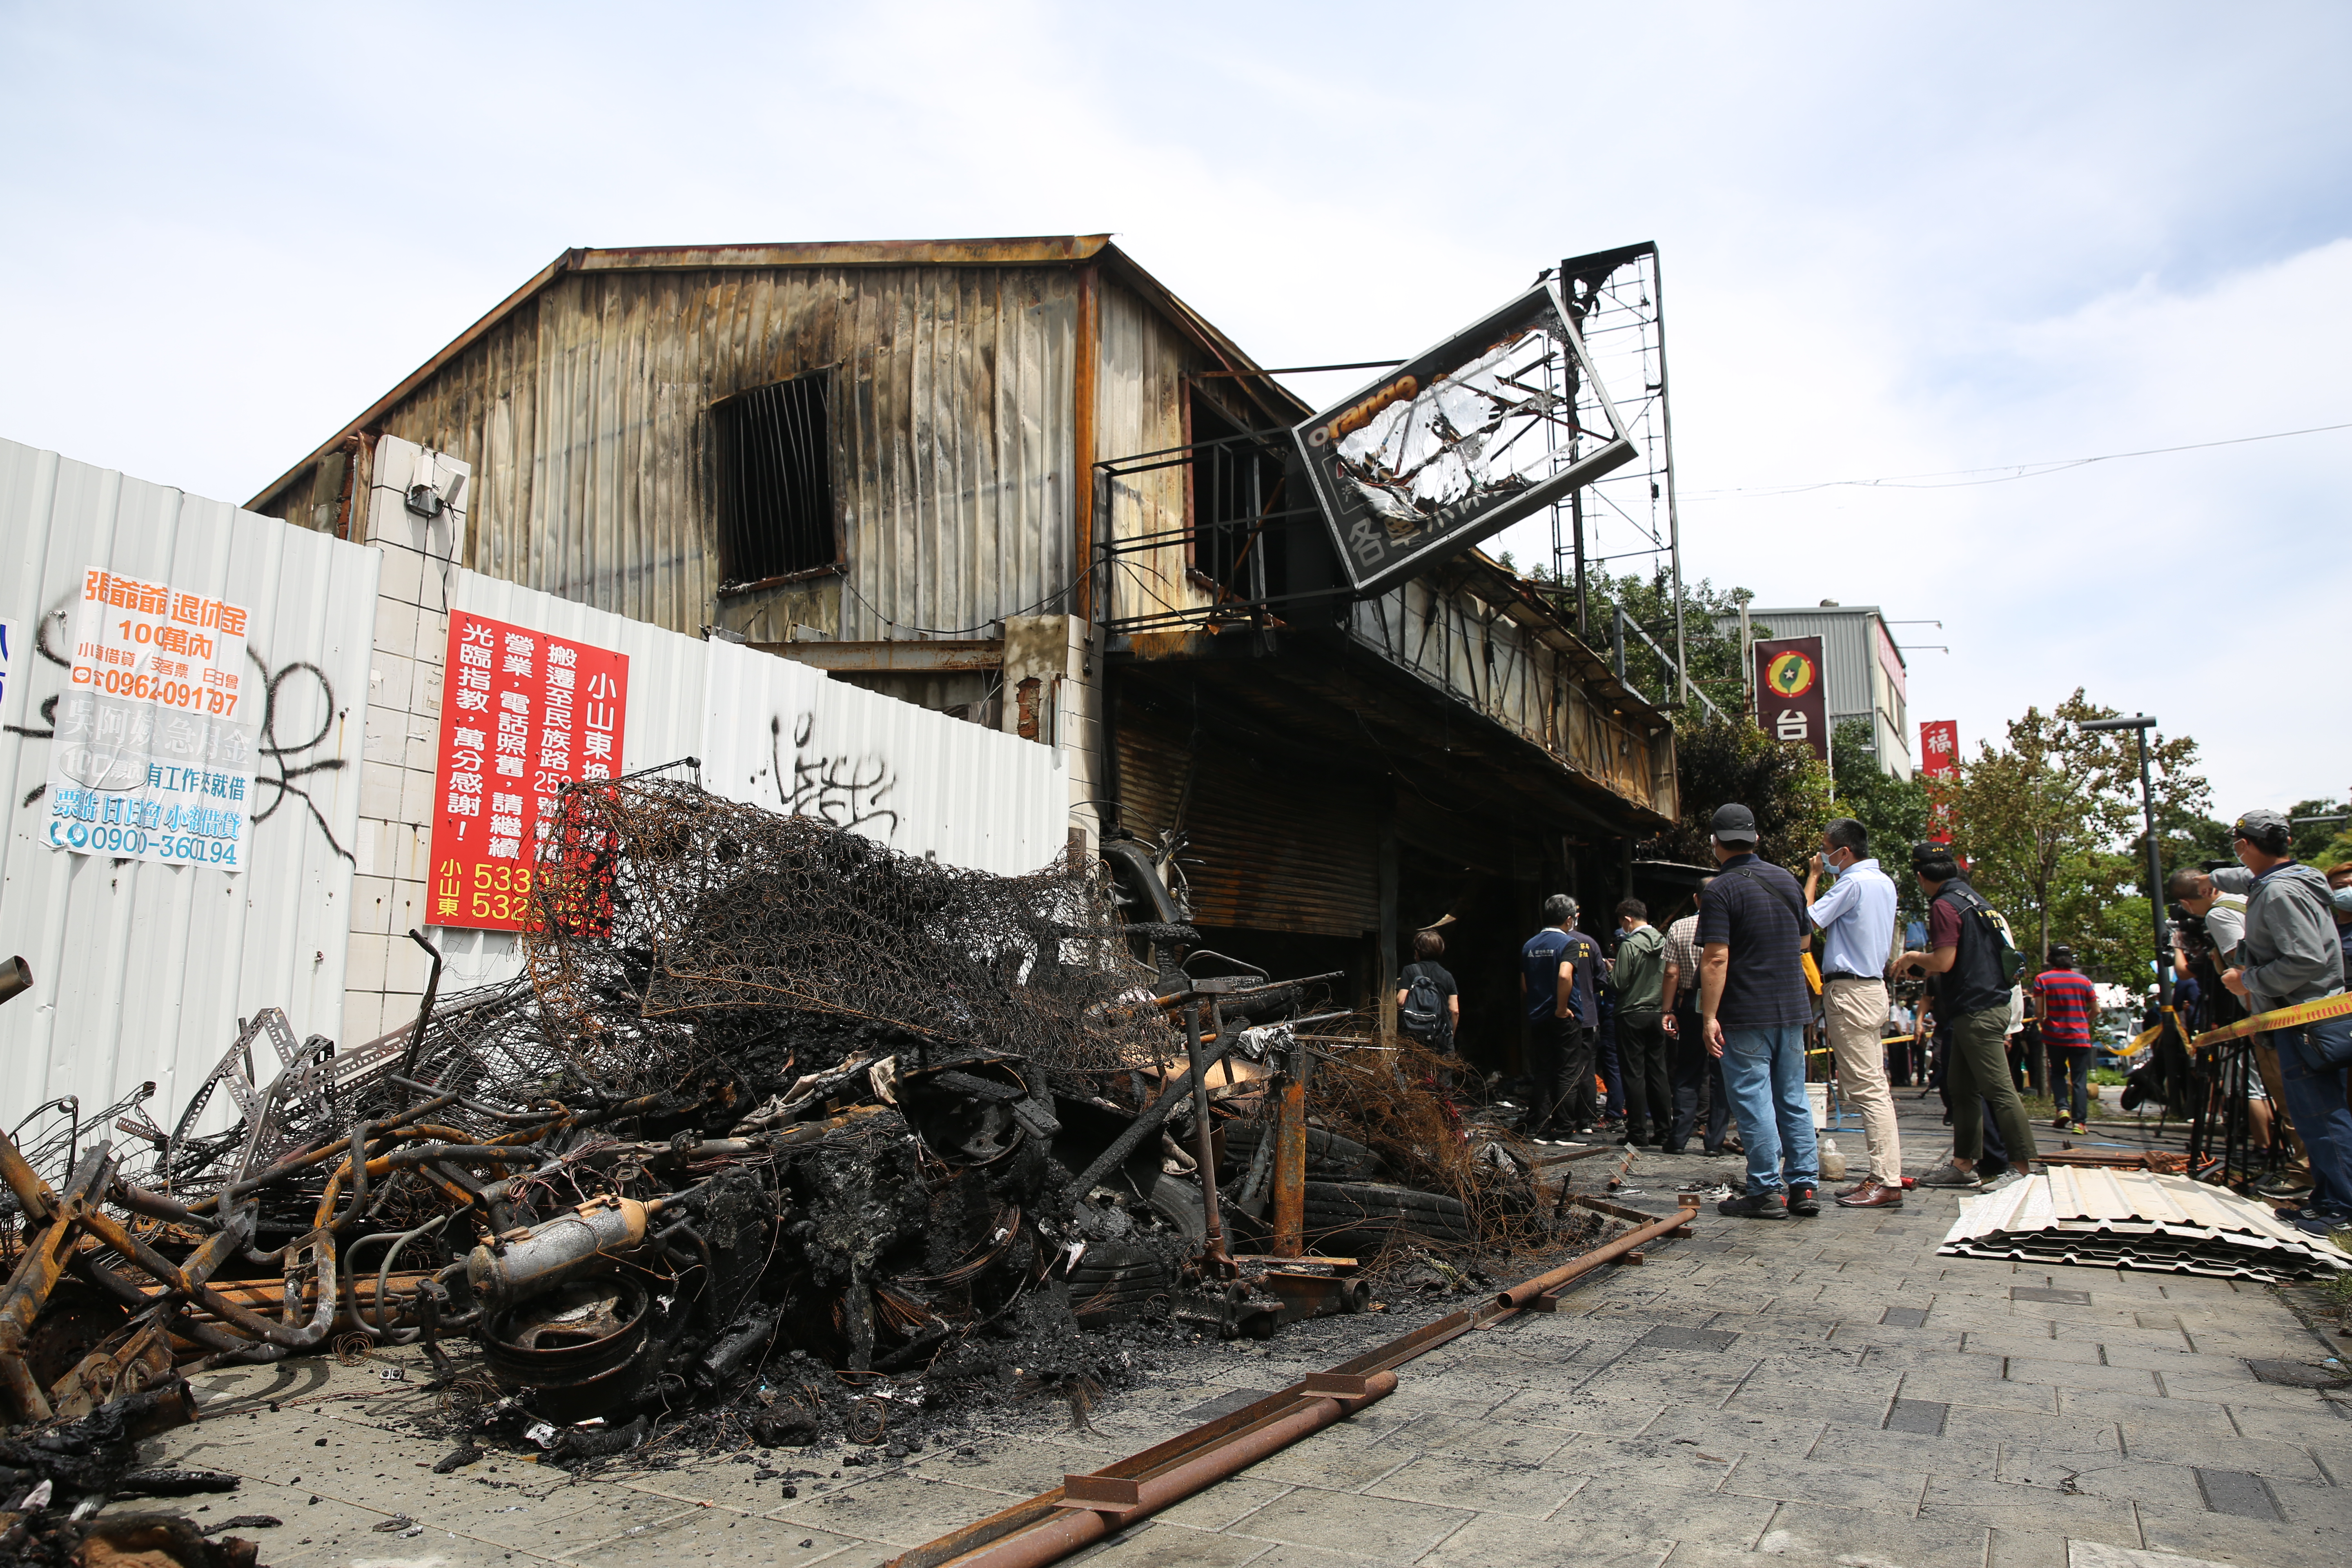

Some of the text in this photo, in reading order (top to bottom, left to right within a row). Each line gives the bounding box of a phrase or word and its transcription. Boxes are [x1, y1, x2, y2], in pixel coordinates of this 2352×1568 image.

[85, 570, 247, 637] 張爺爺 退休金
[118, 620, 213, 660] 100萬內
[78, 642, 136, 668] 小額借貸
[203, 668, 239, 689] 日日會
[105, 669, 238, 716] 0962-091797
[1776, 708, 1808, 741] 台
[147, 762, 246, 801] 有工作來就借
[102, 794, 163, 830] 日日會
[164, 803, 242, 840] 小額借貸
[91, 826, 237, 865] 0900-360194
[437, 858, 462, 916] 小山東
